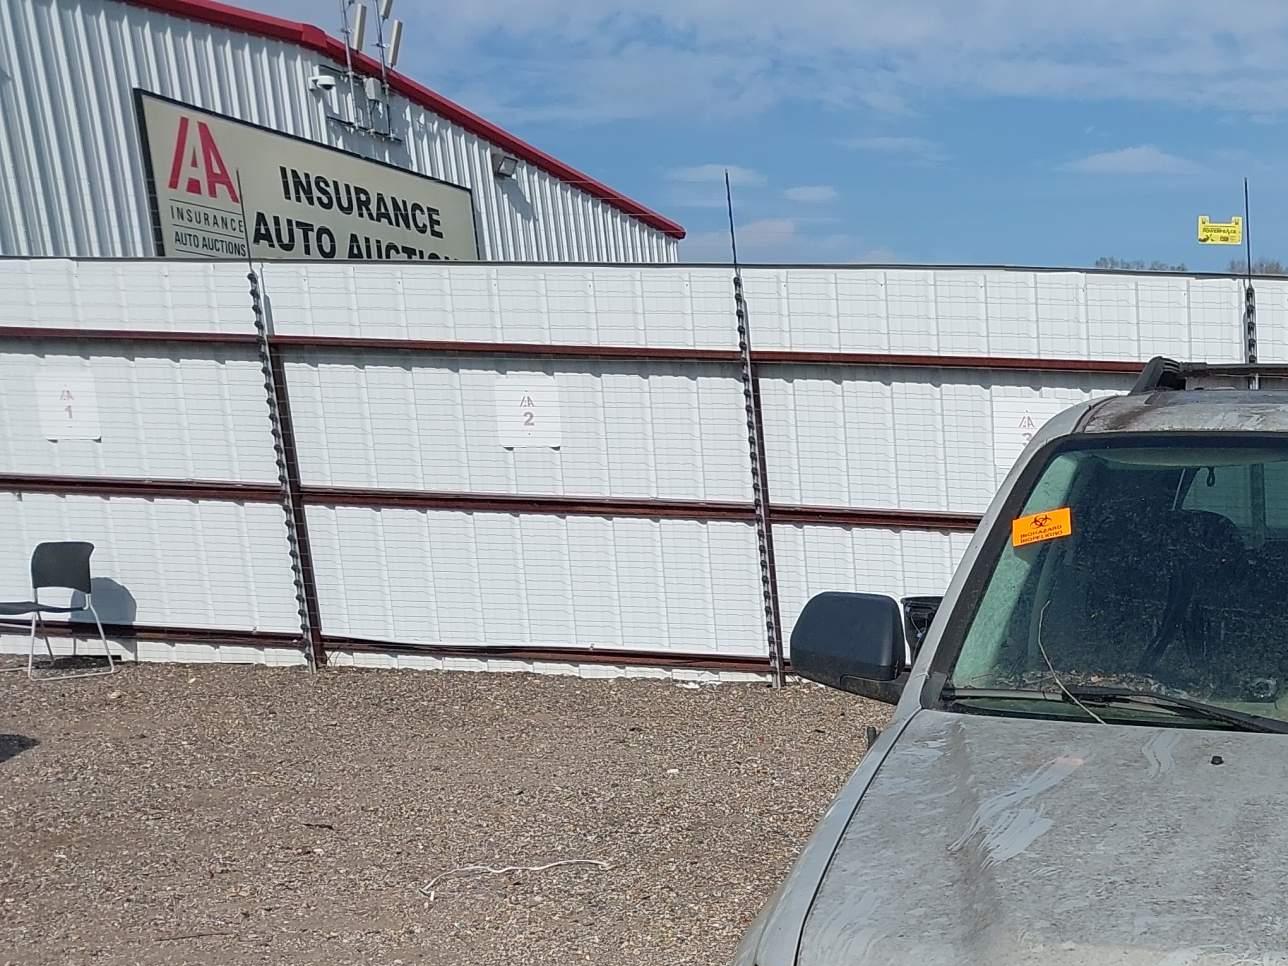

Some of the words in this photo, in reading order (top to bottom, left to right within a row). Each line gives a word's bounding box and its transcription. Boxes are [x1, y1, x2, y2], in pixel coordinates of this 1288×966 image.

[279, 165, 444, 239] INSURANCE
[170, 205, 244, 233] INSURANCE
[174, 231, 200, 249] AUTO
[201, 236, 247, 257] AUCTIONS
[253, 211, 337, 259] AUTO
[523, 411, 535, 426] 2
